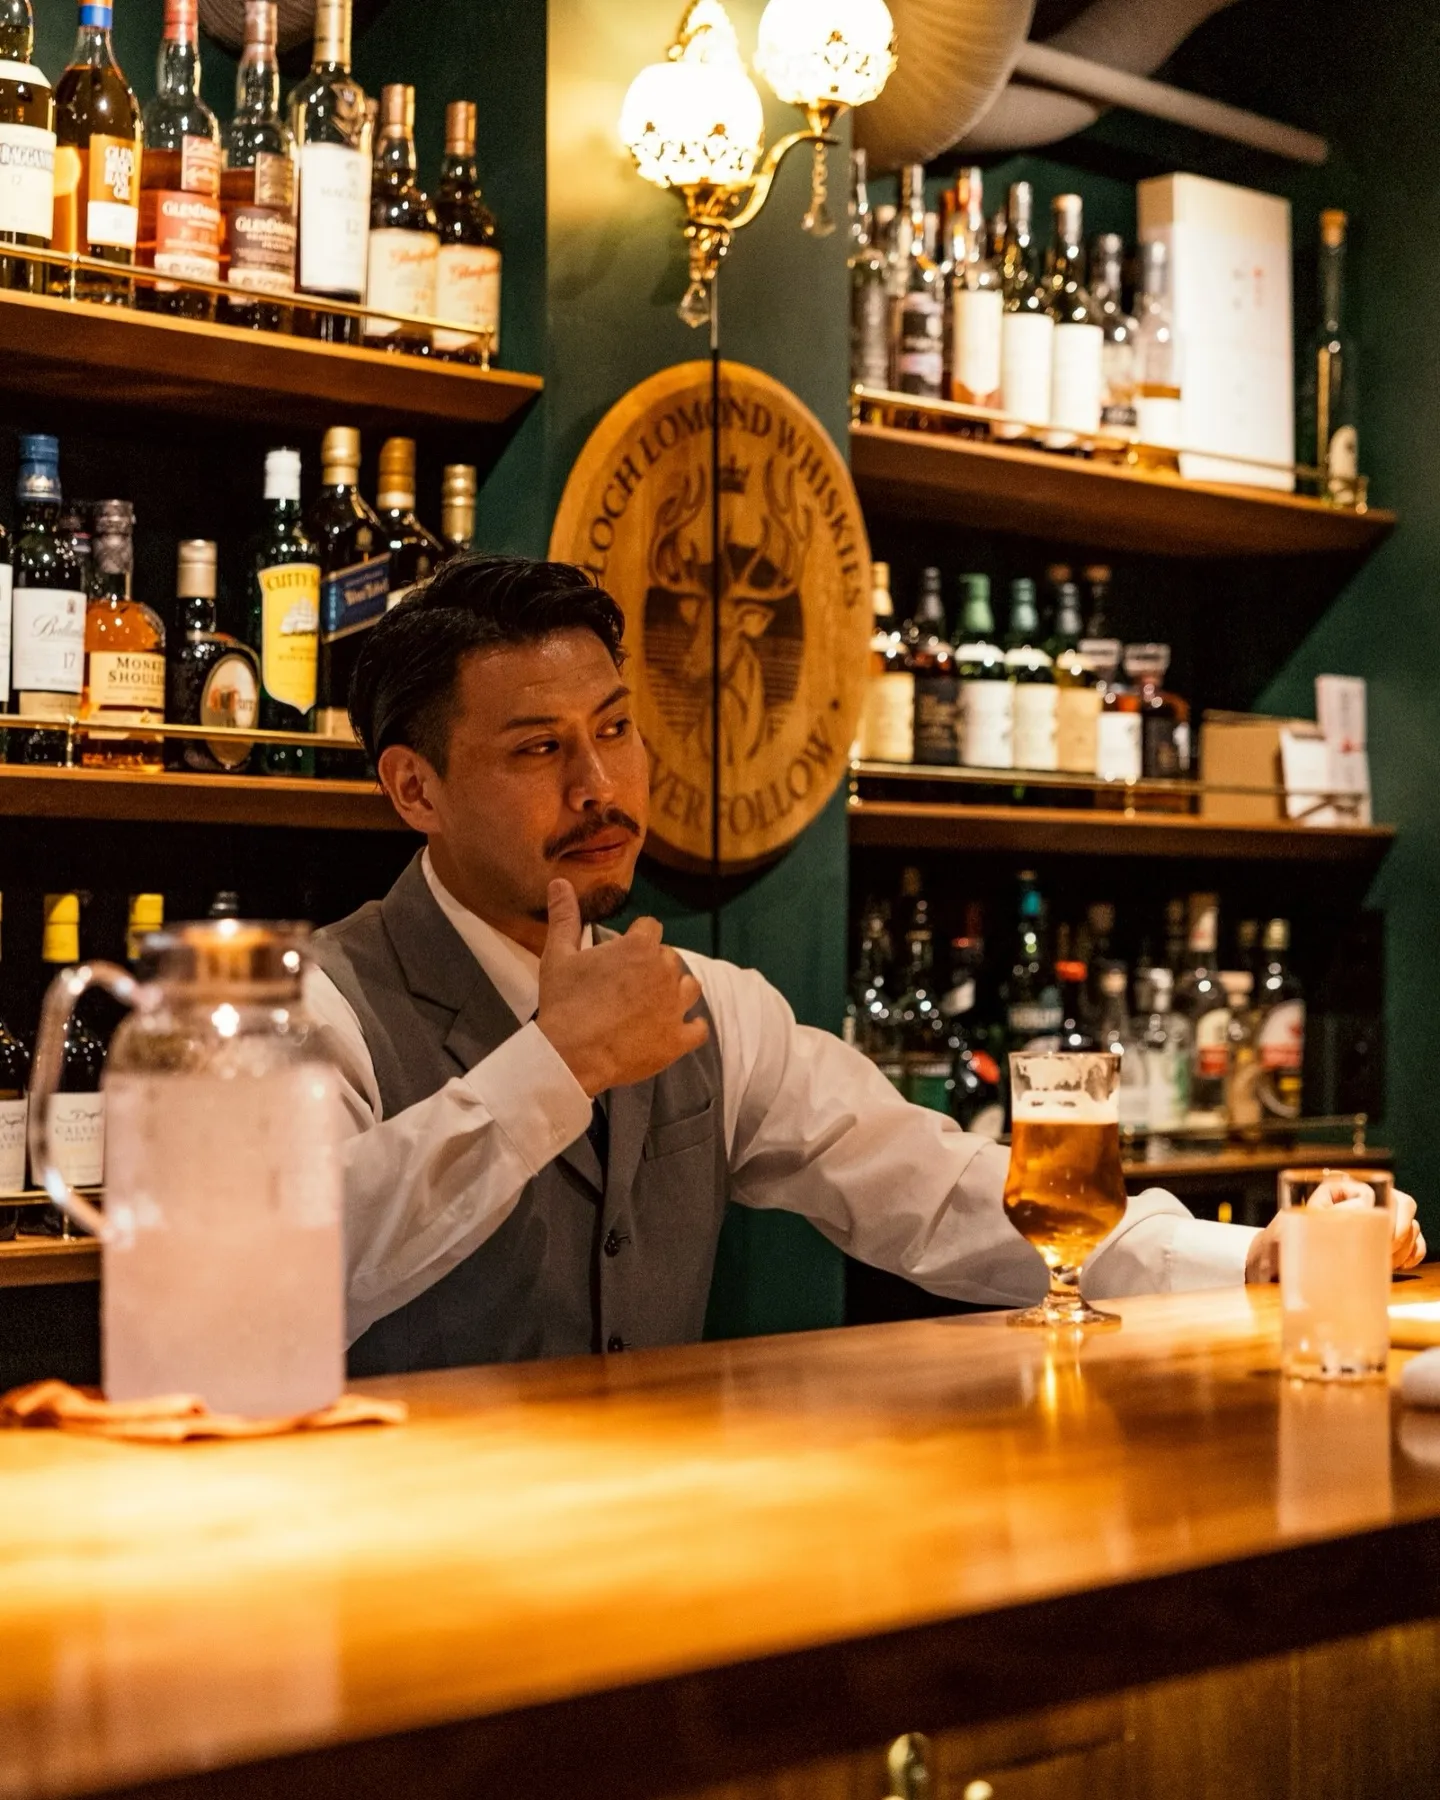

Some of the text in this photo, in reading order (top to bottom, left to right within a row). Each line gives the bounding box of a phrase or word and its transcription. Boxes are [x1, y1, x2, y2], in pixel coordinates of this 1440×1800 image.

[585, 397, 861, 609] LOCH LOMOND WHISKIES
[637, 732, 705, 832] VER
